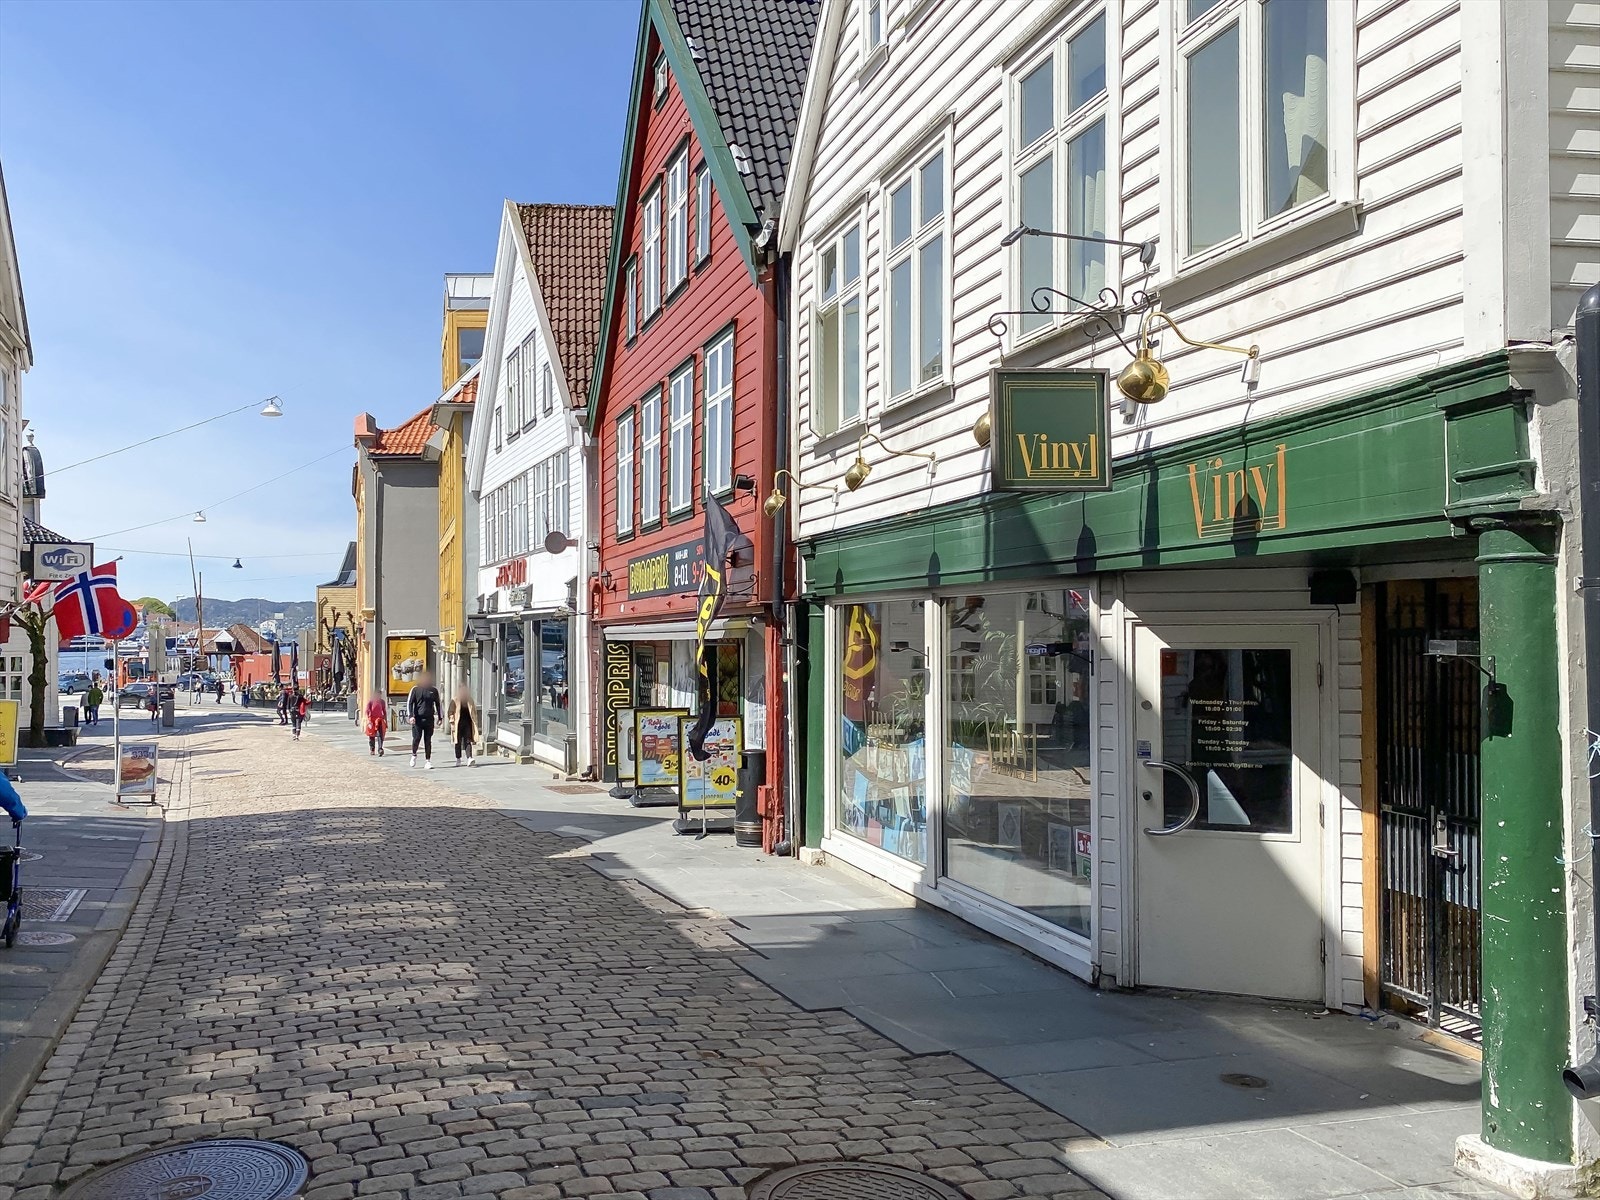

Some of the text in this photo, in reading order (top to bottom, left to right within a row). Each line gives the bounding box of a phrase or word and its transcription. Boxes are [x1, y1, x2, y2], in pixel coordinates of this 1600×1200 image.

[1016, 432, 1097, 478] Vinyl
[1186, 444, 1287, 539] Vinyl
[674, 563, 689, 587] 8-01
[664, 759, 671, 770] 3
